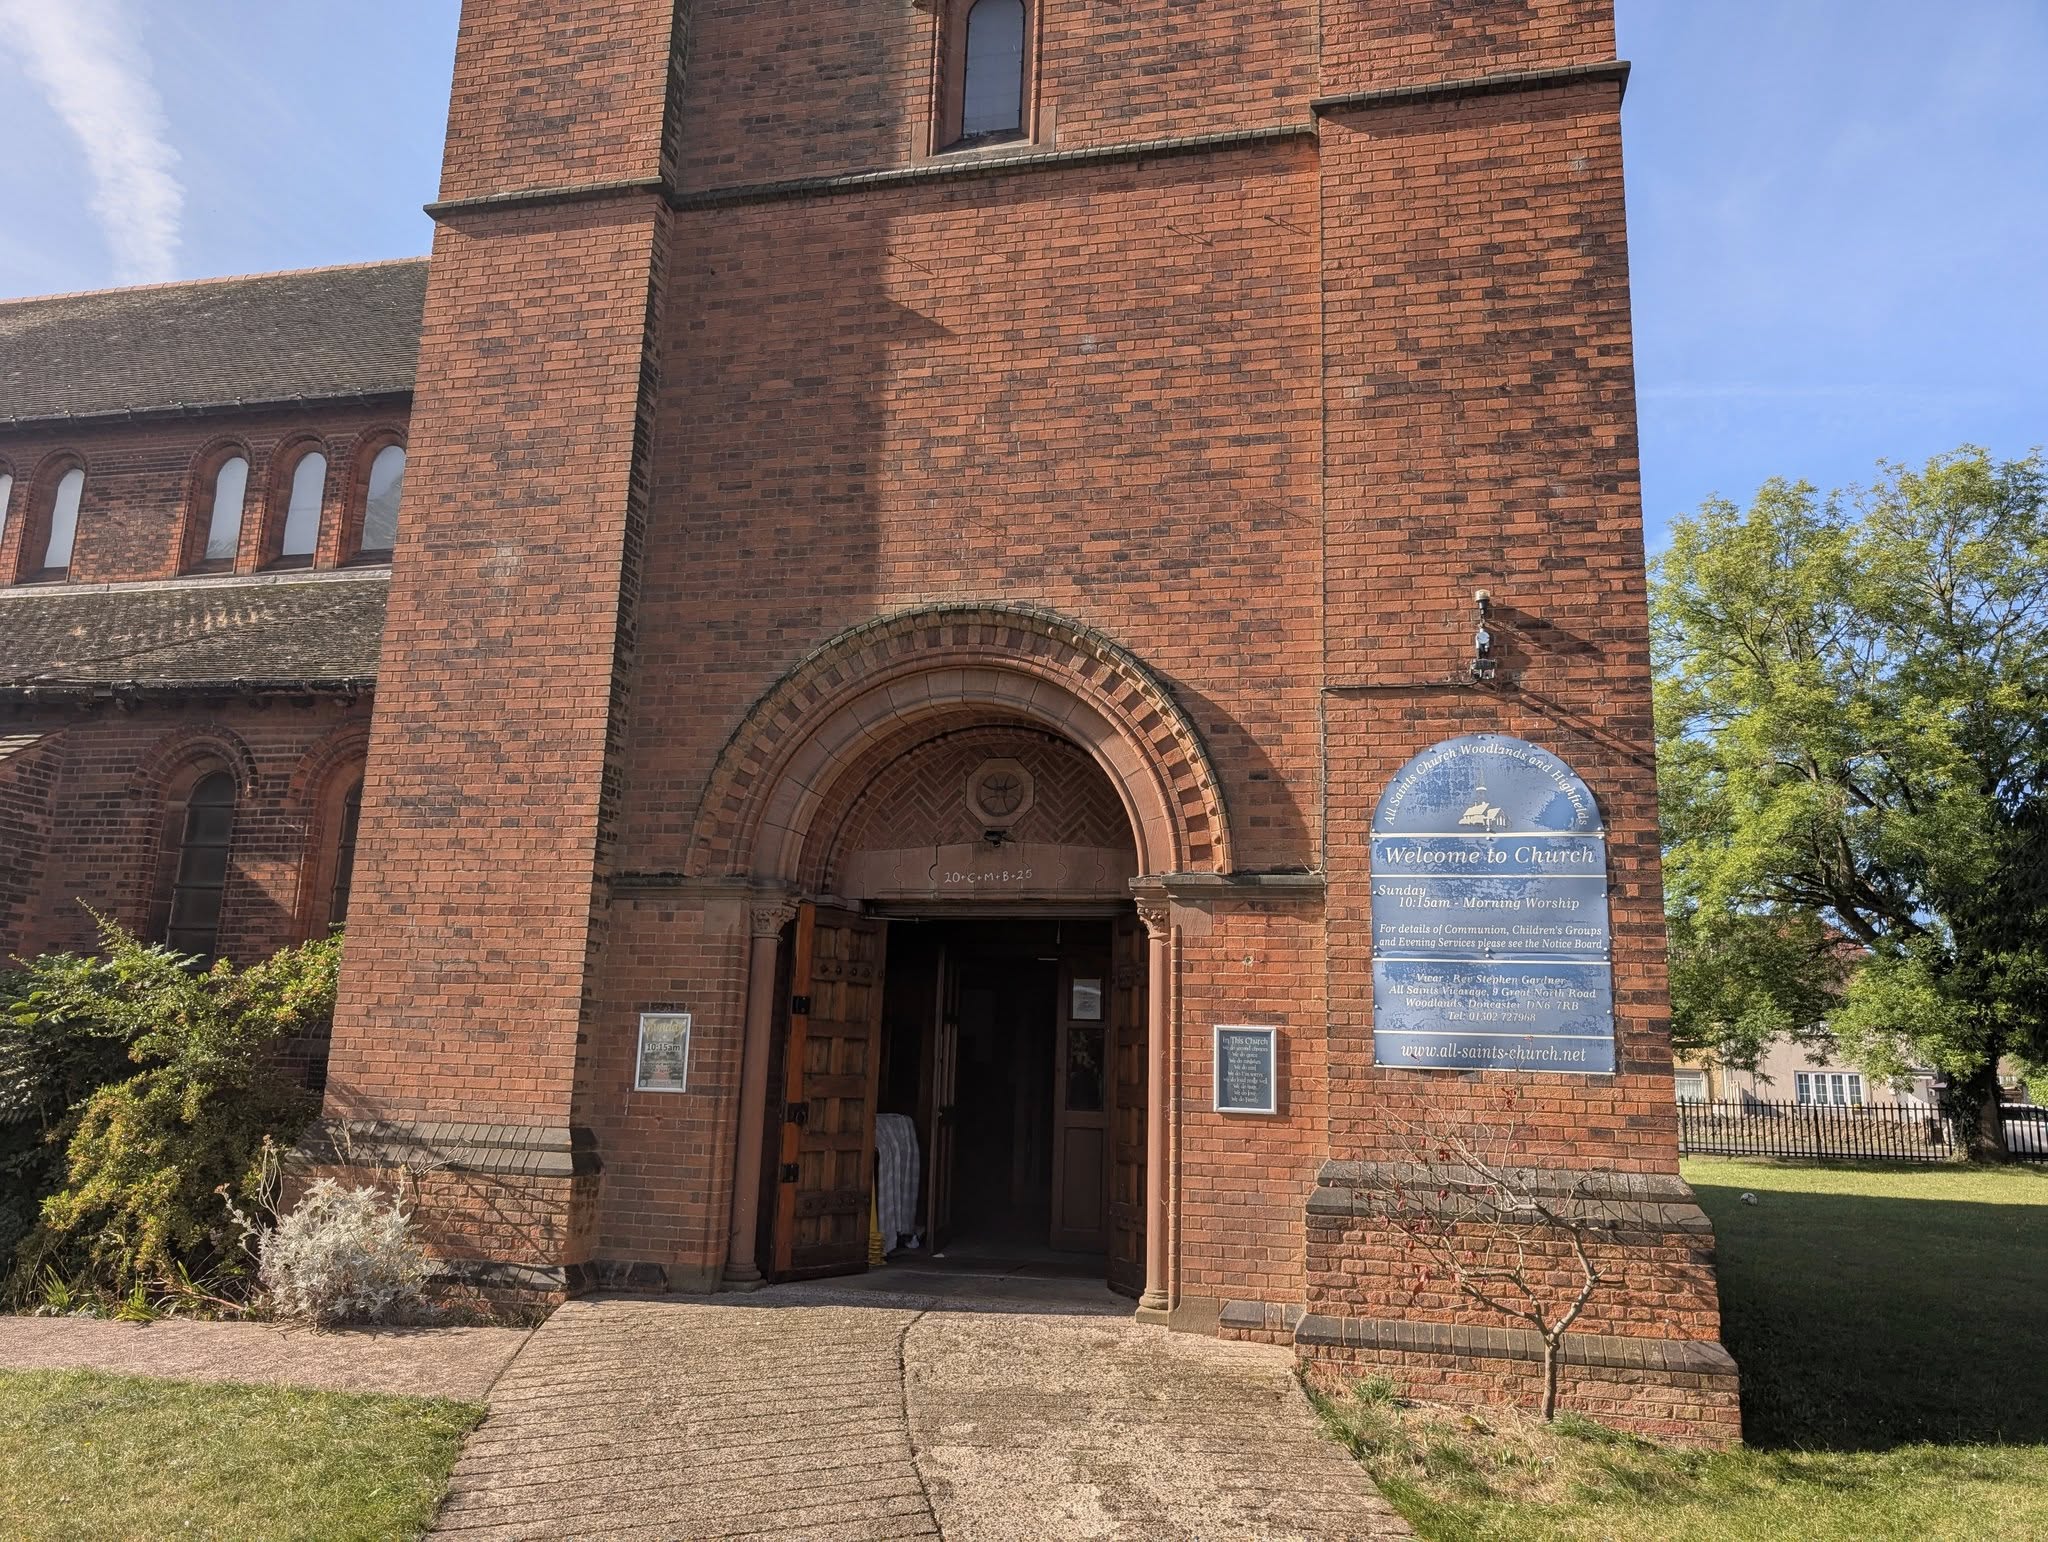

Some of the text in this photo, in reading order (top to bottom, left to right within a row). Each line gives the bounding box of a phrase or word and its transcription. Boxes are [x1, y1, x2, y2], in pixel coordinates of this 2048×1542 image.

[1384, 743, 1588, 826] All Saints Church Woodlands and Highfields
[1385, 846, 1594, 864] Welcome to Church
[1379, 884, 1426, 898] Sunday
[1399, 897, 1450, 908] 10:15am
[1463, 898, 1521, 910] Morning
[1525, 898, 1580, 910] Worship
[1379, 924, 1602, 937] For details of Communion, Children's Groups
[1379, 938, 1396, 947] and
[1399, 938, 1436, 948] Evening
[1438, 938, 1475, 948] Services
[1477, 939, 1506, 950] please
[1525, 939, 1540, 948] the
[1542, 939, 1572, 949] Notice
[1575, 940, 1602, 949] Board
[1416, 973, 1444, 982] Vicar
[1453, 975, 1473, 983] Rev
[1476, 975, 1518, 985] Stephen
[1521, 975, 1566, 985] Gardner
[1389, 985, 1404, 994] All
[1406, 986, 1439, 995] Saints
[1492, 988, 1498, 997] 9
[1501, 988, 1530, 997] Great
[1534, 988, 1565, 998] North
[1568, 989, 1596, 998] Road
[1468, 1000, 1521, 1009] Doncaster
[1526, 1001, 1551, 1010] DN6
[1557, 1002, 1579, 1011] 7RB
[1447, 1011, 1465, 1020] Tel:
[1469, 1013, 1498, 1021] 01302
[1223, 1036, 1229, 1044] In
[1245, 1037, 1268, 1045] Church
[647, 1043, 681, 1052] 10:15am
[1401, 1043, 1586, 1062] www.all-saints-church.net
